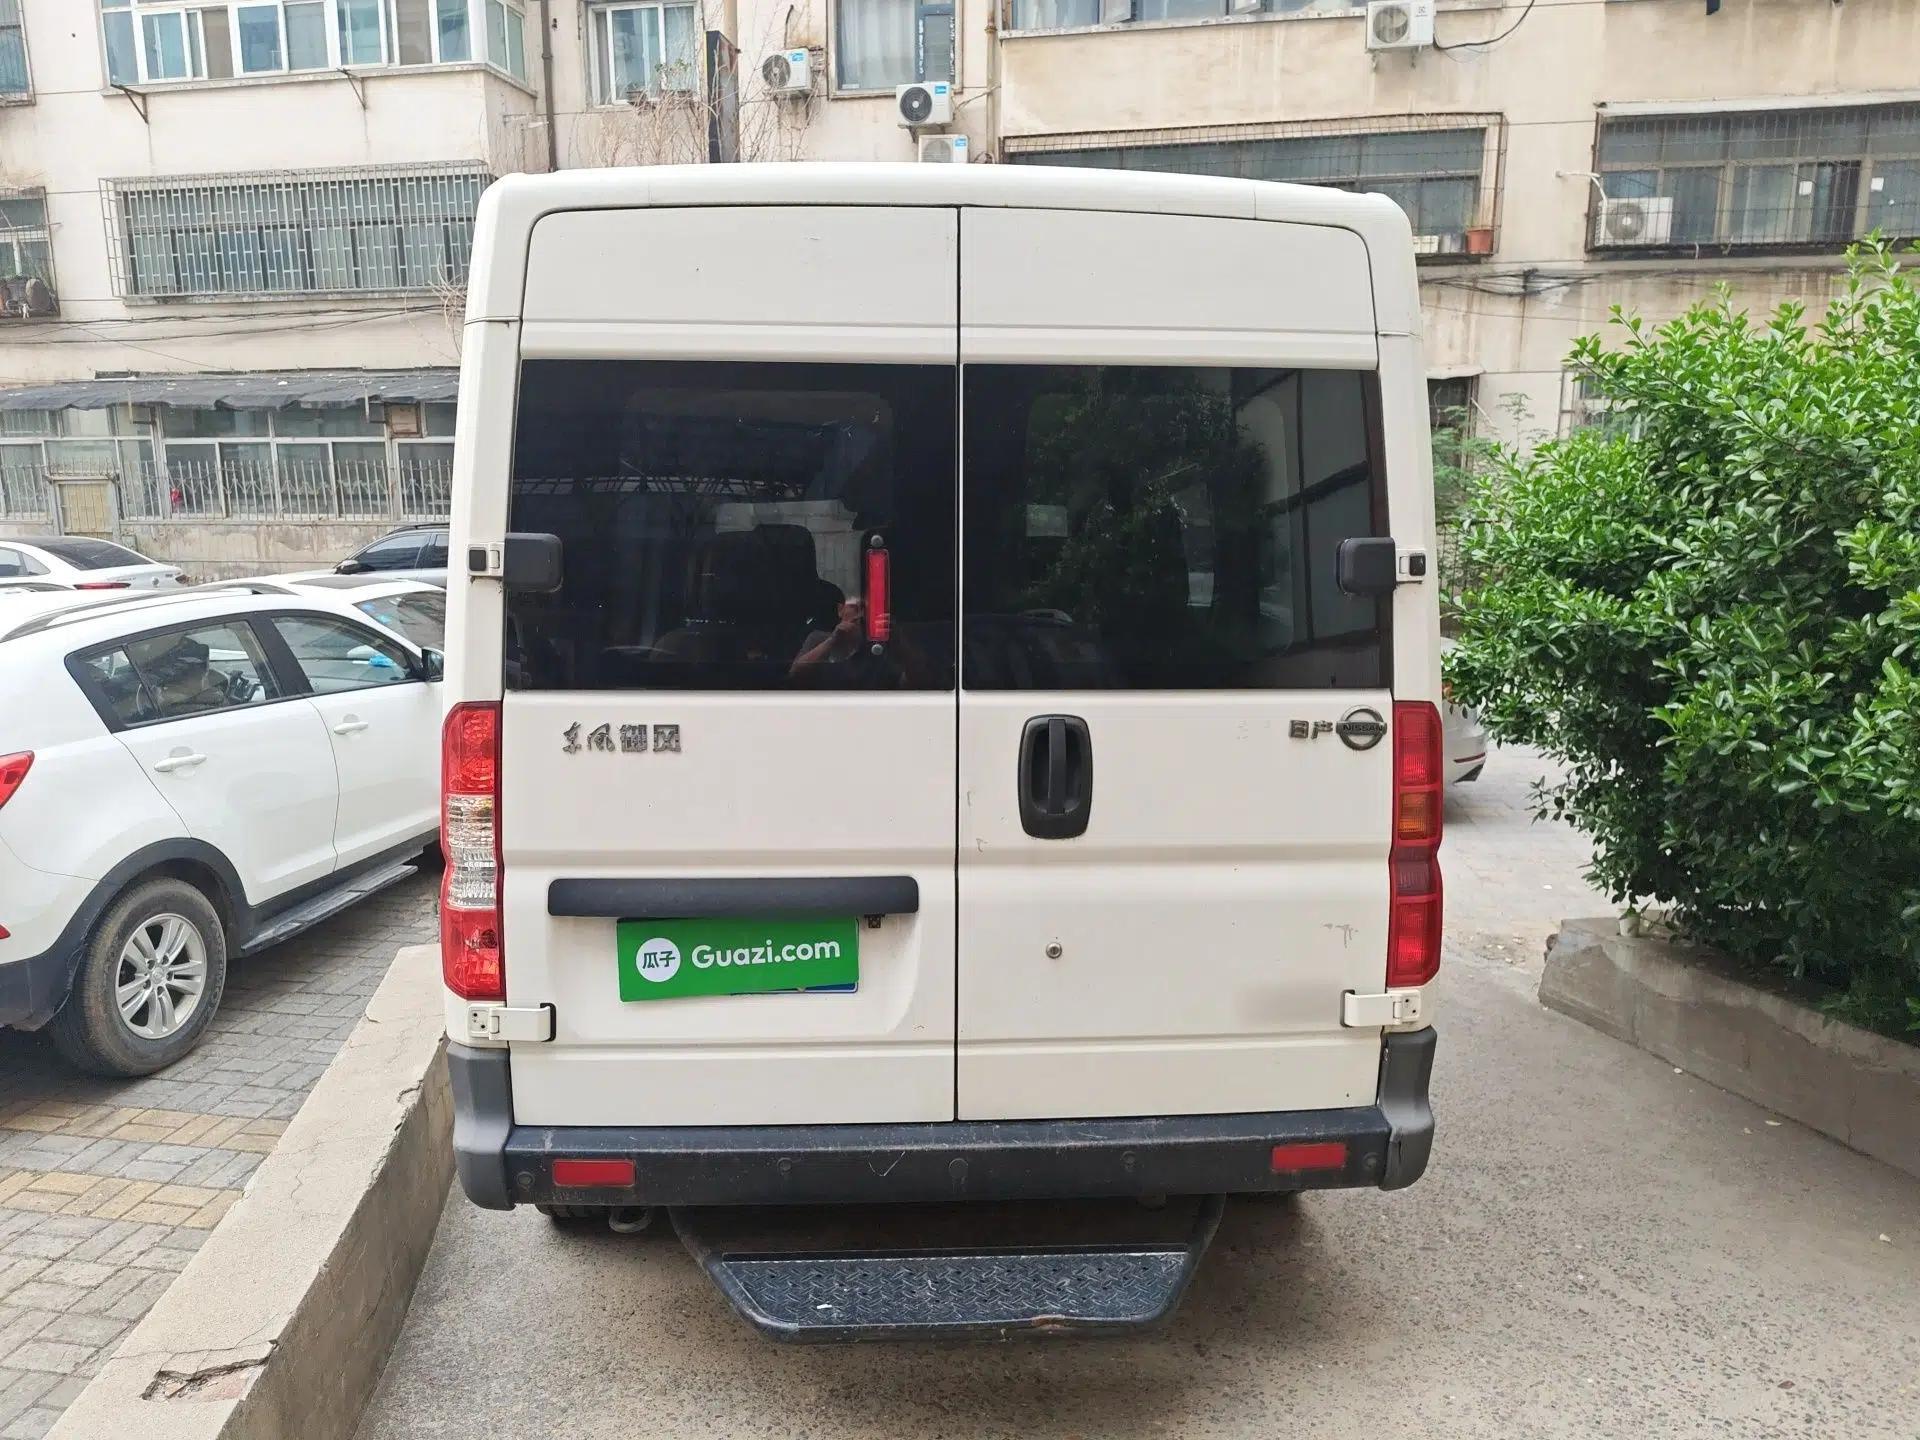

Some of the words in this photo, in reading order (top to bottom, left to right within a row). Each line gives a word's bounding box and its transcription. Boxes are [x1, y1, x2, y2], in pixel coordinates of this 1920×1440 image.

[1288, 720, 1334, 740] 日产
[1342, 722, 1384, 734] NISSAN
[641, 951, 676, 969] 瓜子
[691, 939, 841, 969] Guazi.com
